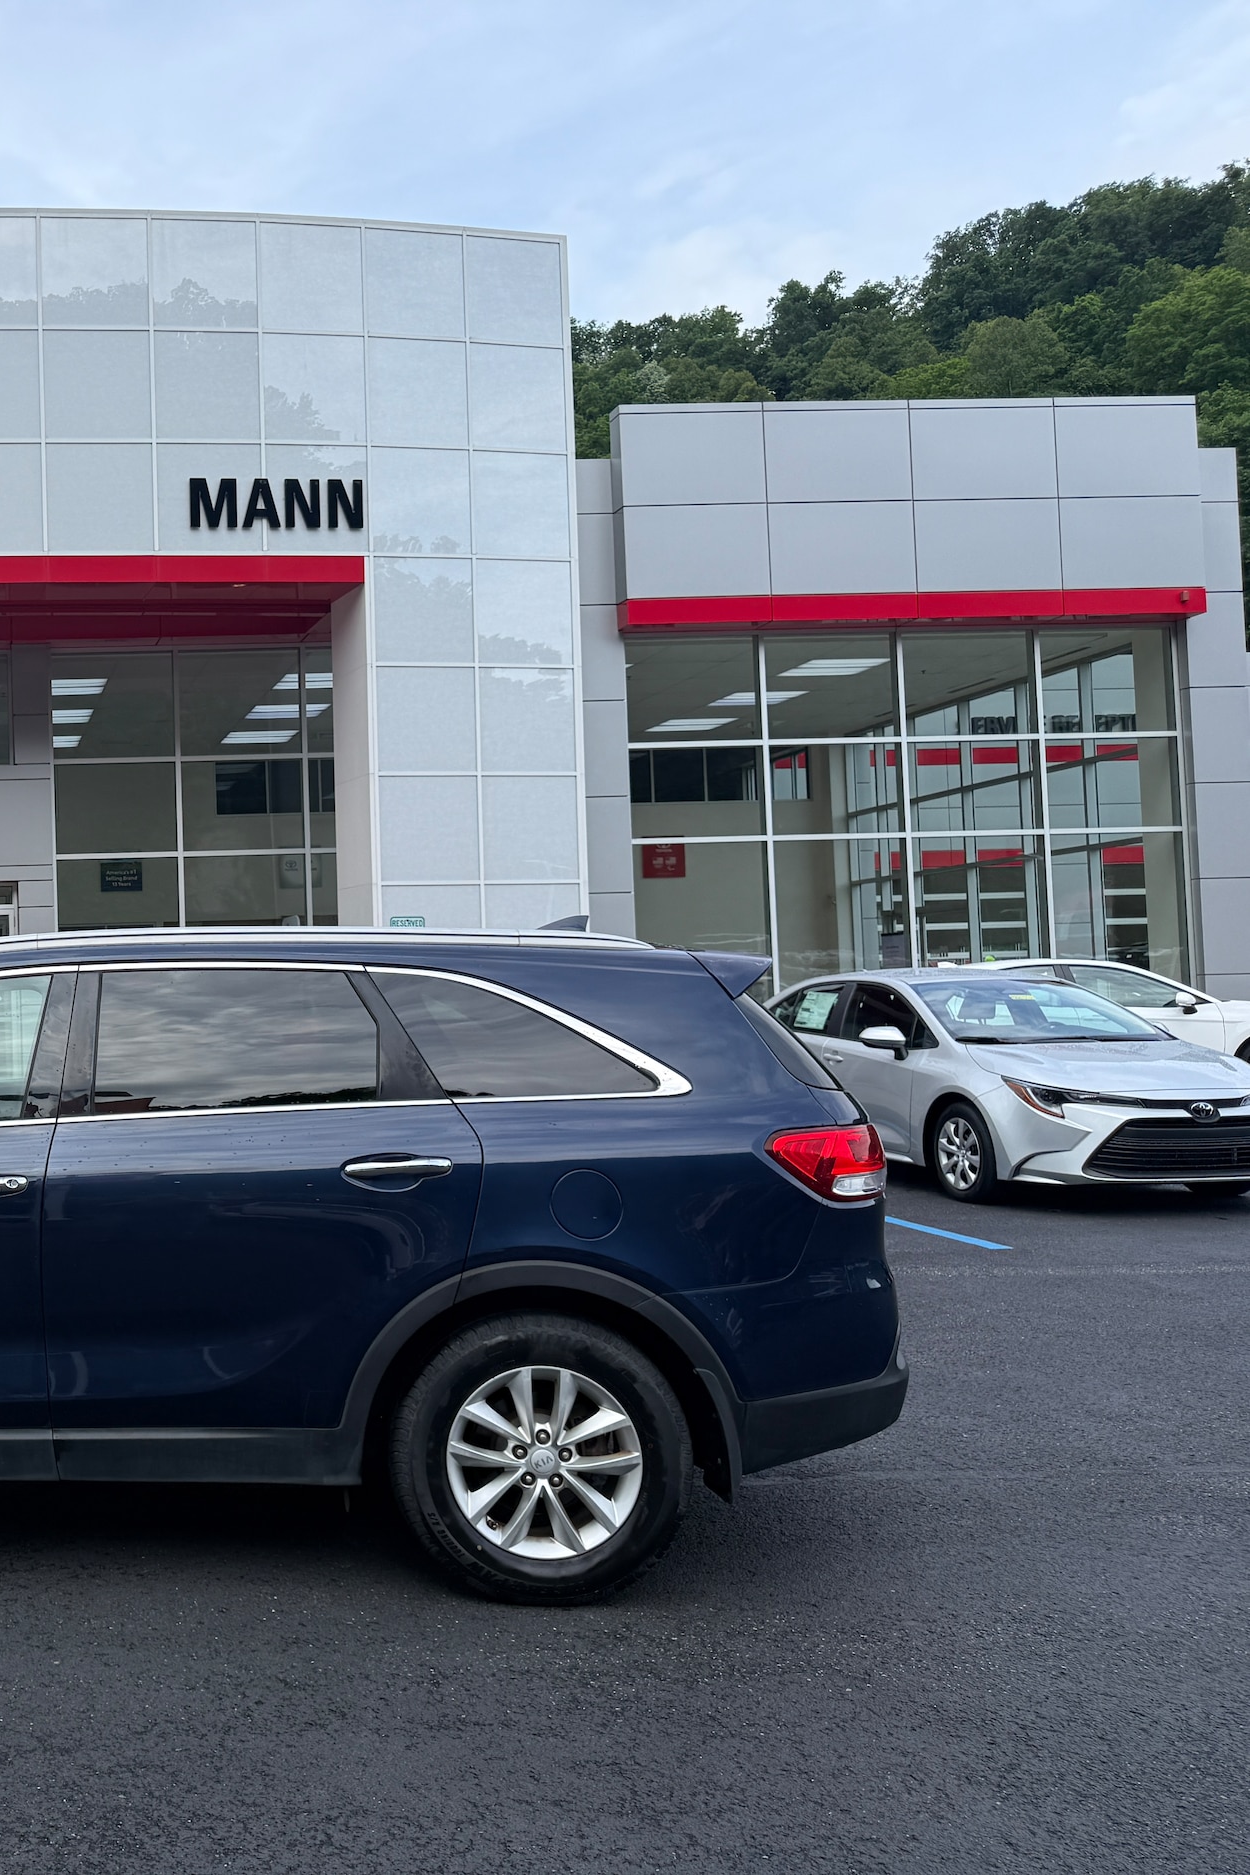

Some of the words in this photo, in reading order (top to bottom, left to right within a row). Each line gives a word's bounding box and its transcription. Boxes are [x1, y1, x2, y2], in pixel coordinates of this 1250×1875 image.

[189, 477, 364, 530] MANN
[391, 919, 423, 927] RESERVED
[533, 1456, 554, 1469] KIA
